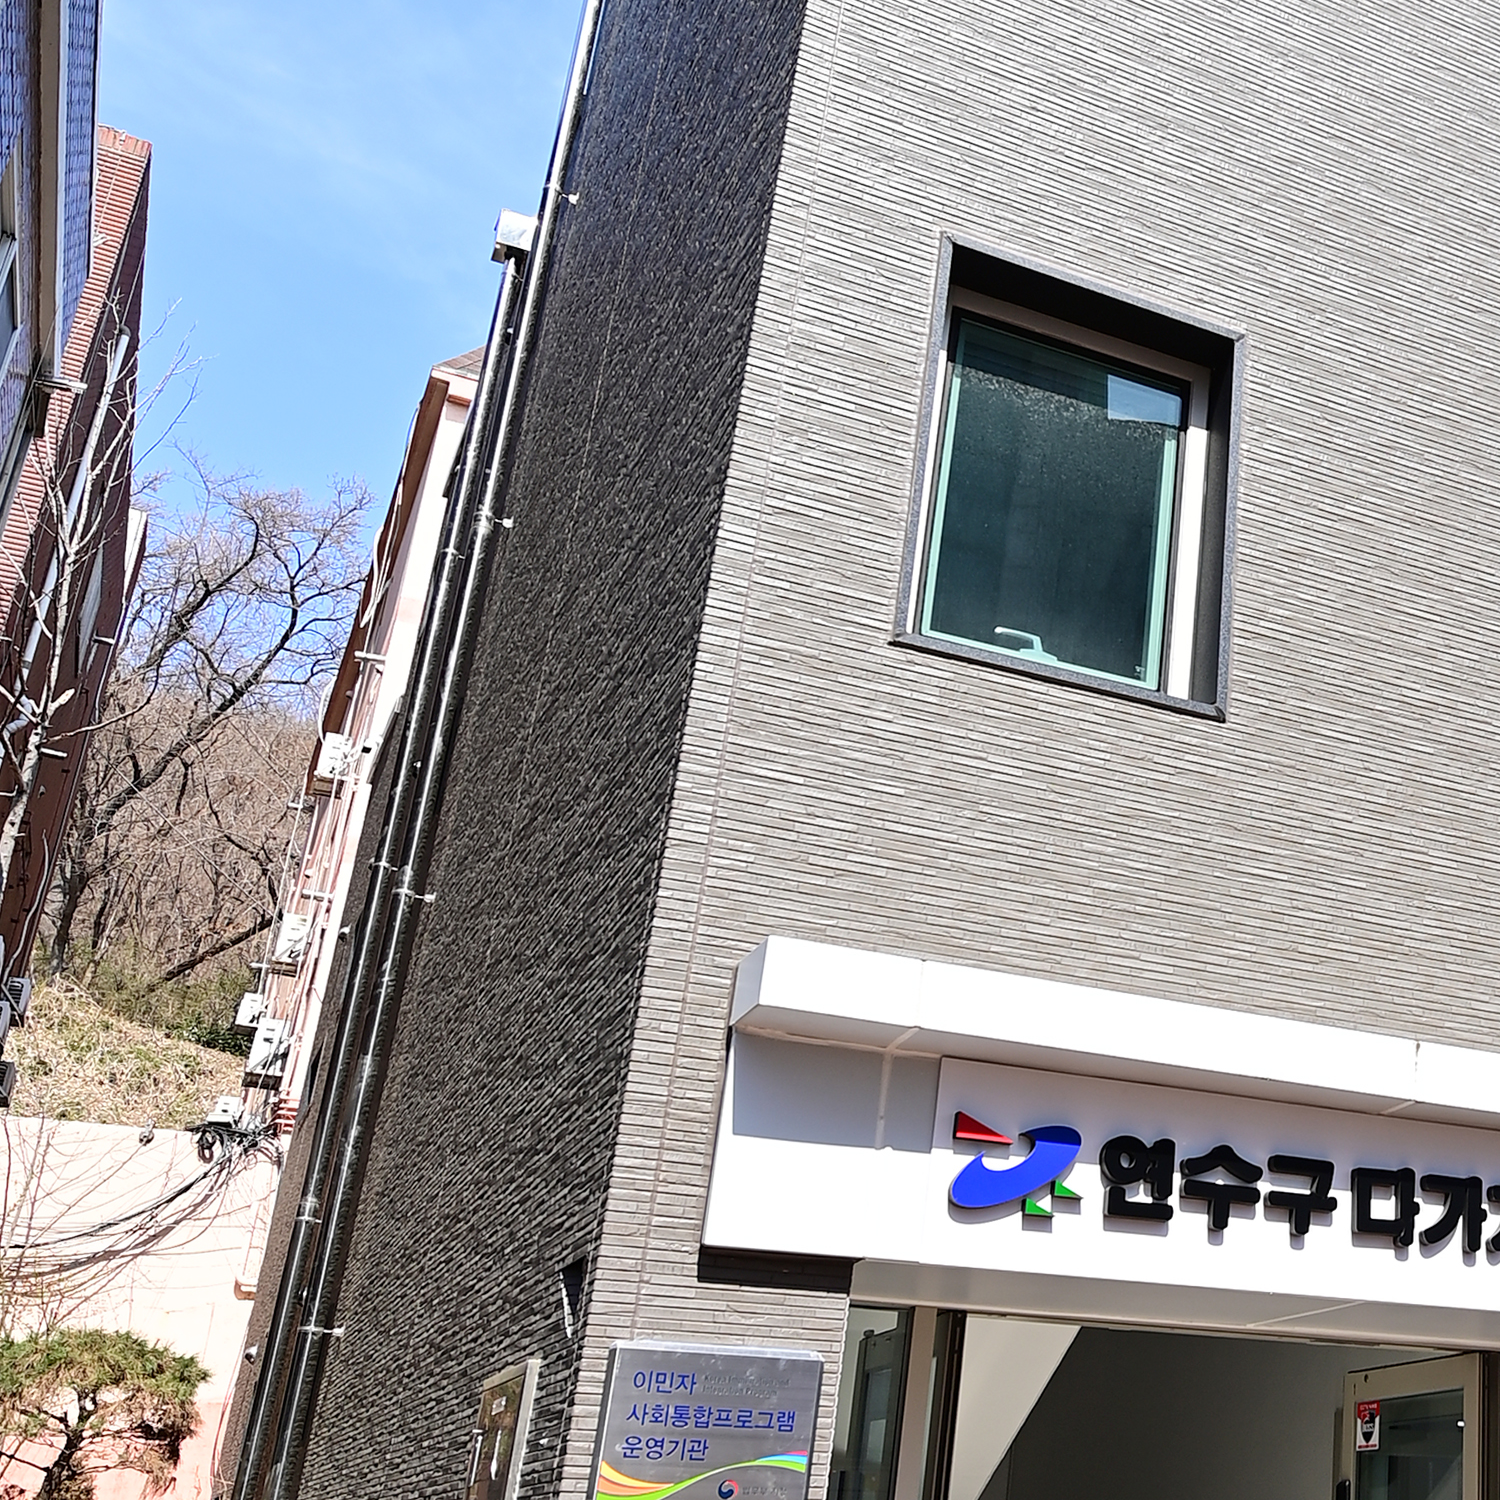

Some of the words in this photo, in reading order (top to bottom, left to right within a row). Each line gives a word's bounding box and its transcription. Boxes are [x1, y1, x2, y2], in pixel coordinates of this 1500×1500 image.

[1099, 1134, 1338, 1235] 연수구
[633, 1370, 697, 1395] 이민자
[625, 1403, 796, 1432] 사회통합프로그램
[621, 1435, 709, 1461] 운영기관
